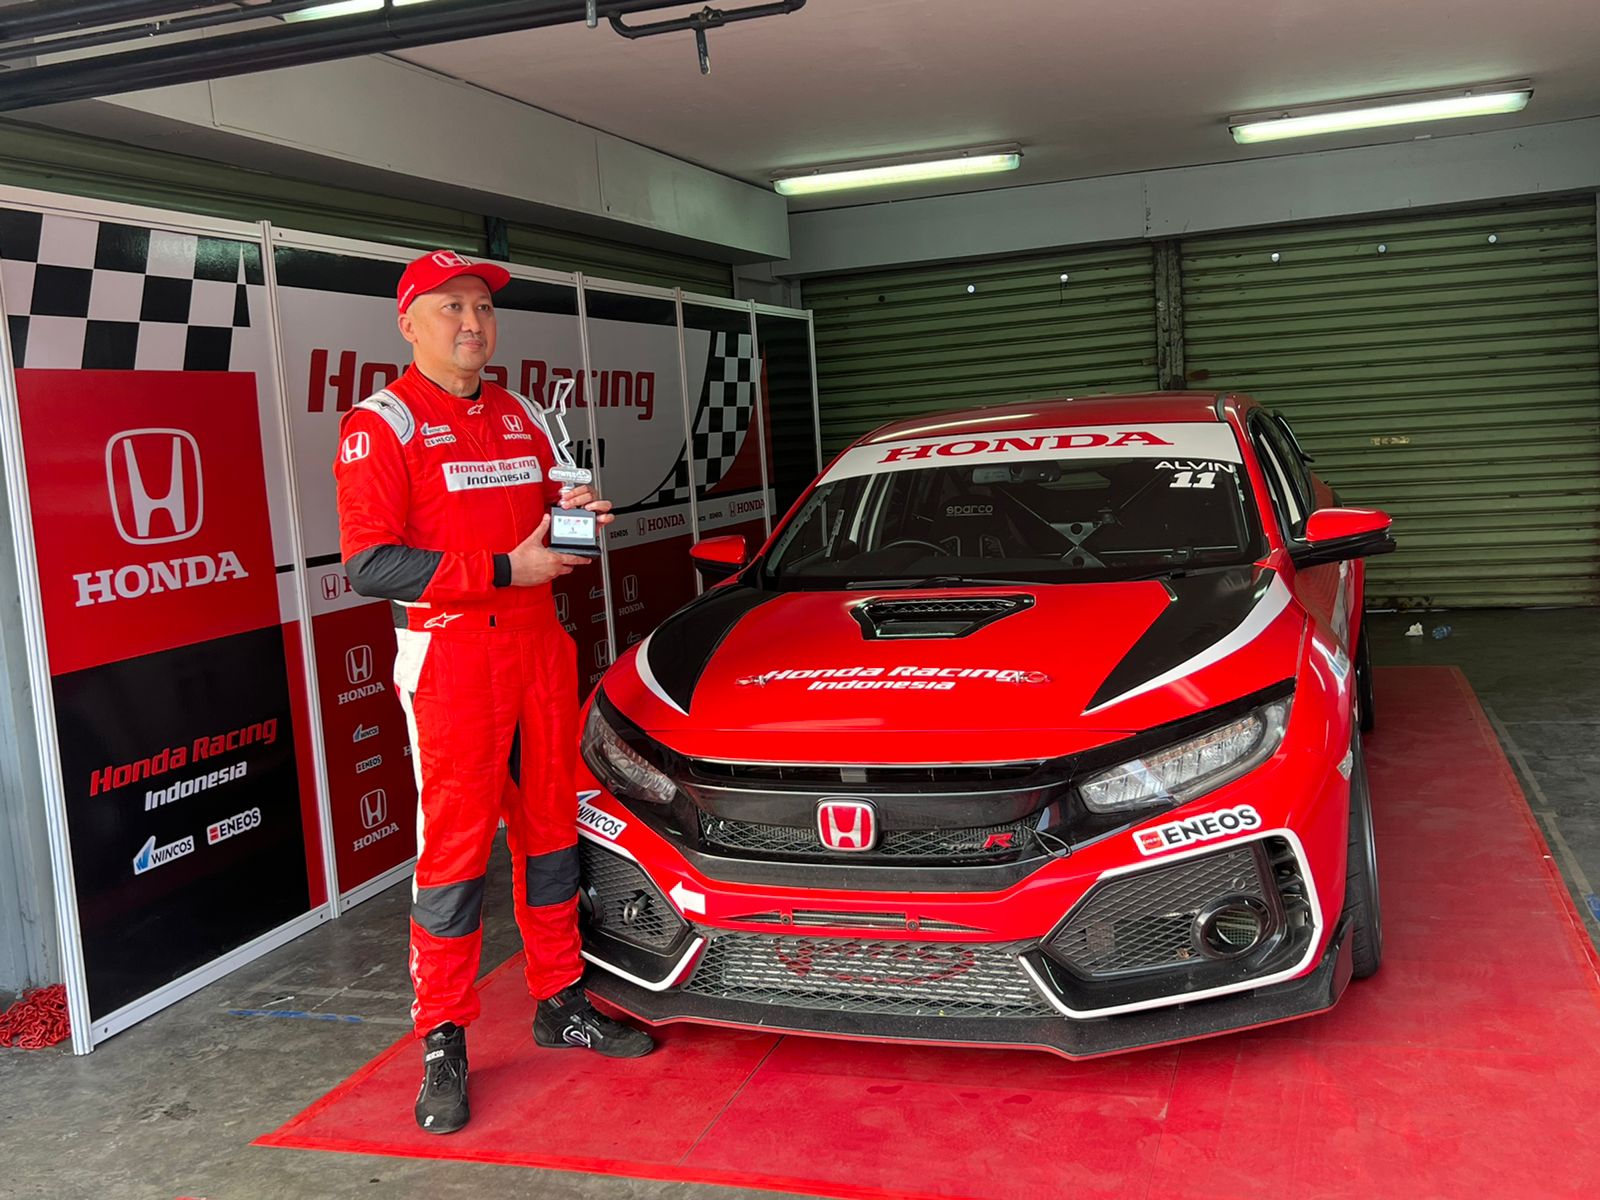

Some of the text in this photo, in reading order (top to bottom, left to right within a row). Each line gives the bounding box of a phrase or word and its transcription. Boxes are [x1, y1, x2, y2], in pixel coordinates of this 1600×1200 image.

[520, 359, 655, 420] Racing
[877, 431, 1174, 463] HONDA
[449, 459, 537, 475] Honda Racing
[467, 471, 530, 485] Indonesia
[1154, 461, 1233, 473] ALVIN
[1169, 471, 1216, 488] 11
[647, 514, 686, 532] HONDA
[946, 504, 993, 518] sparco
[73, 551, 248, 607] HONDA
[765, 665, 1024, 683] Honda Racing
[806, 680, 957, 691] Indonesia
[337, 681, 385, 705] HONDA
[90, 718, 278, 797] Honda Racing
[144, 761, 248, 811] Indonesia
[219, 810, 260, 838] ENEOS
[1162, 808, 1257, 845] ENEOS
[353, 822, 399, 852] HONDA
[983, 833, 1014, 848] R
[151, 839, 193, 865] WINCOS
